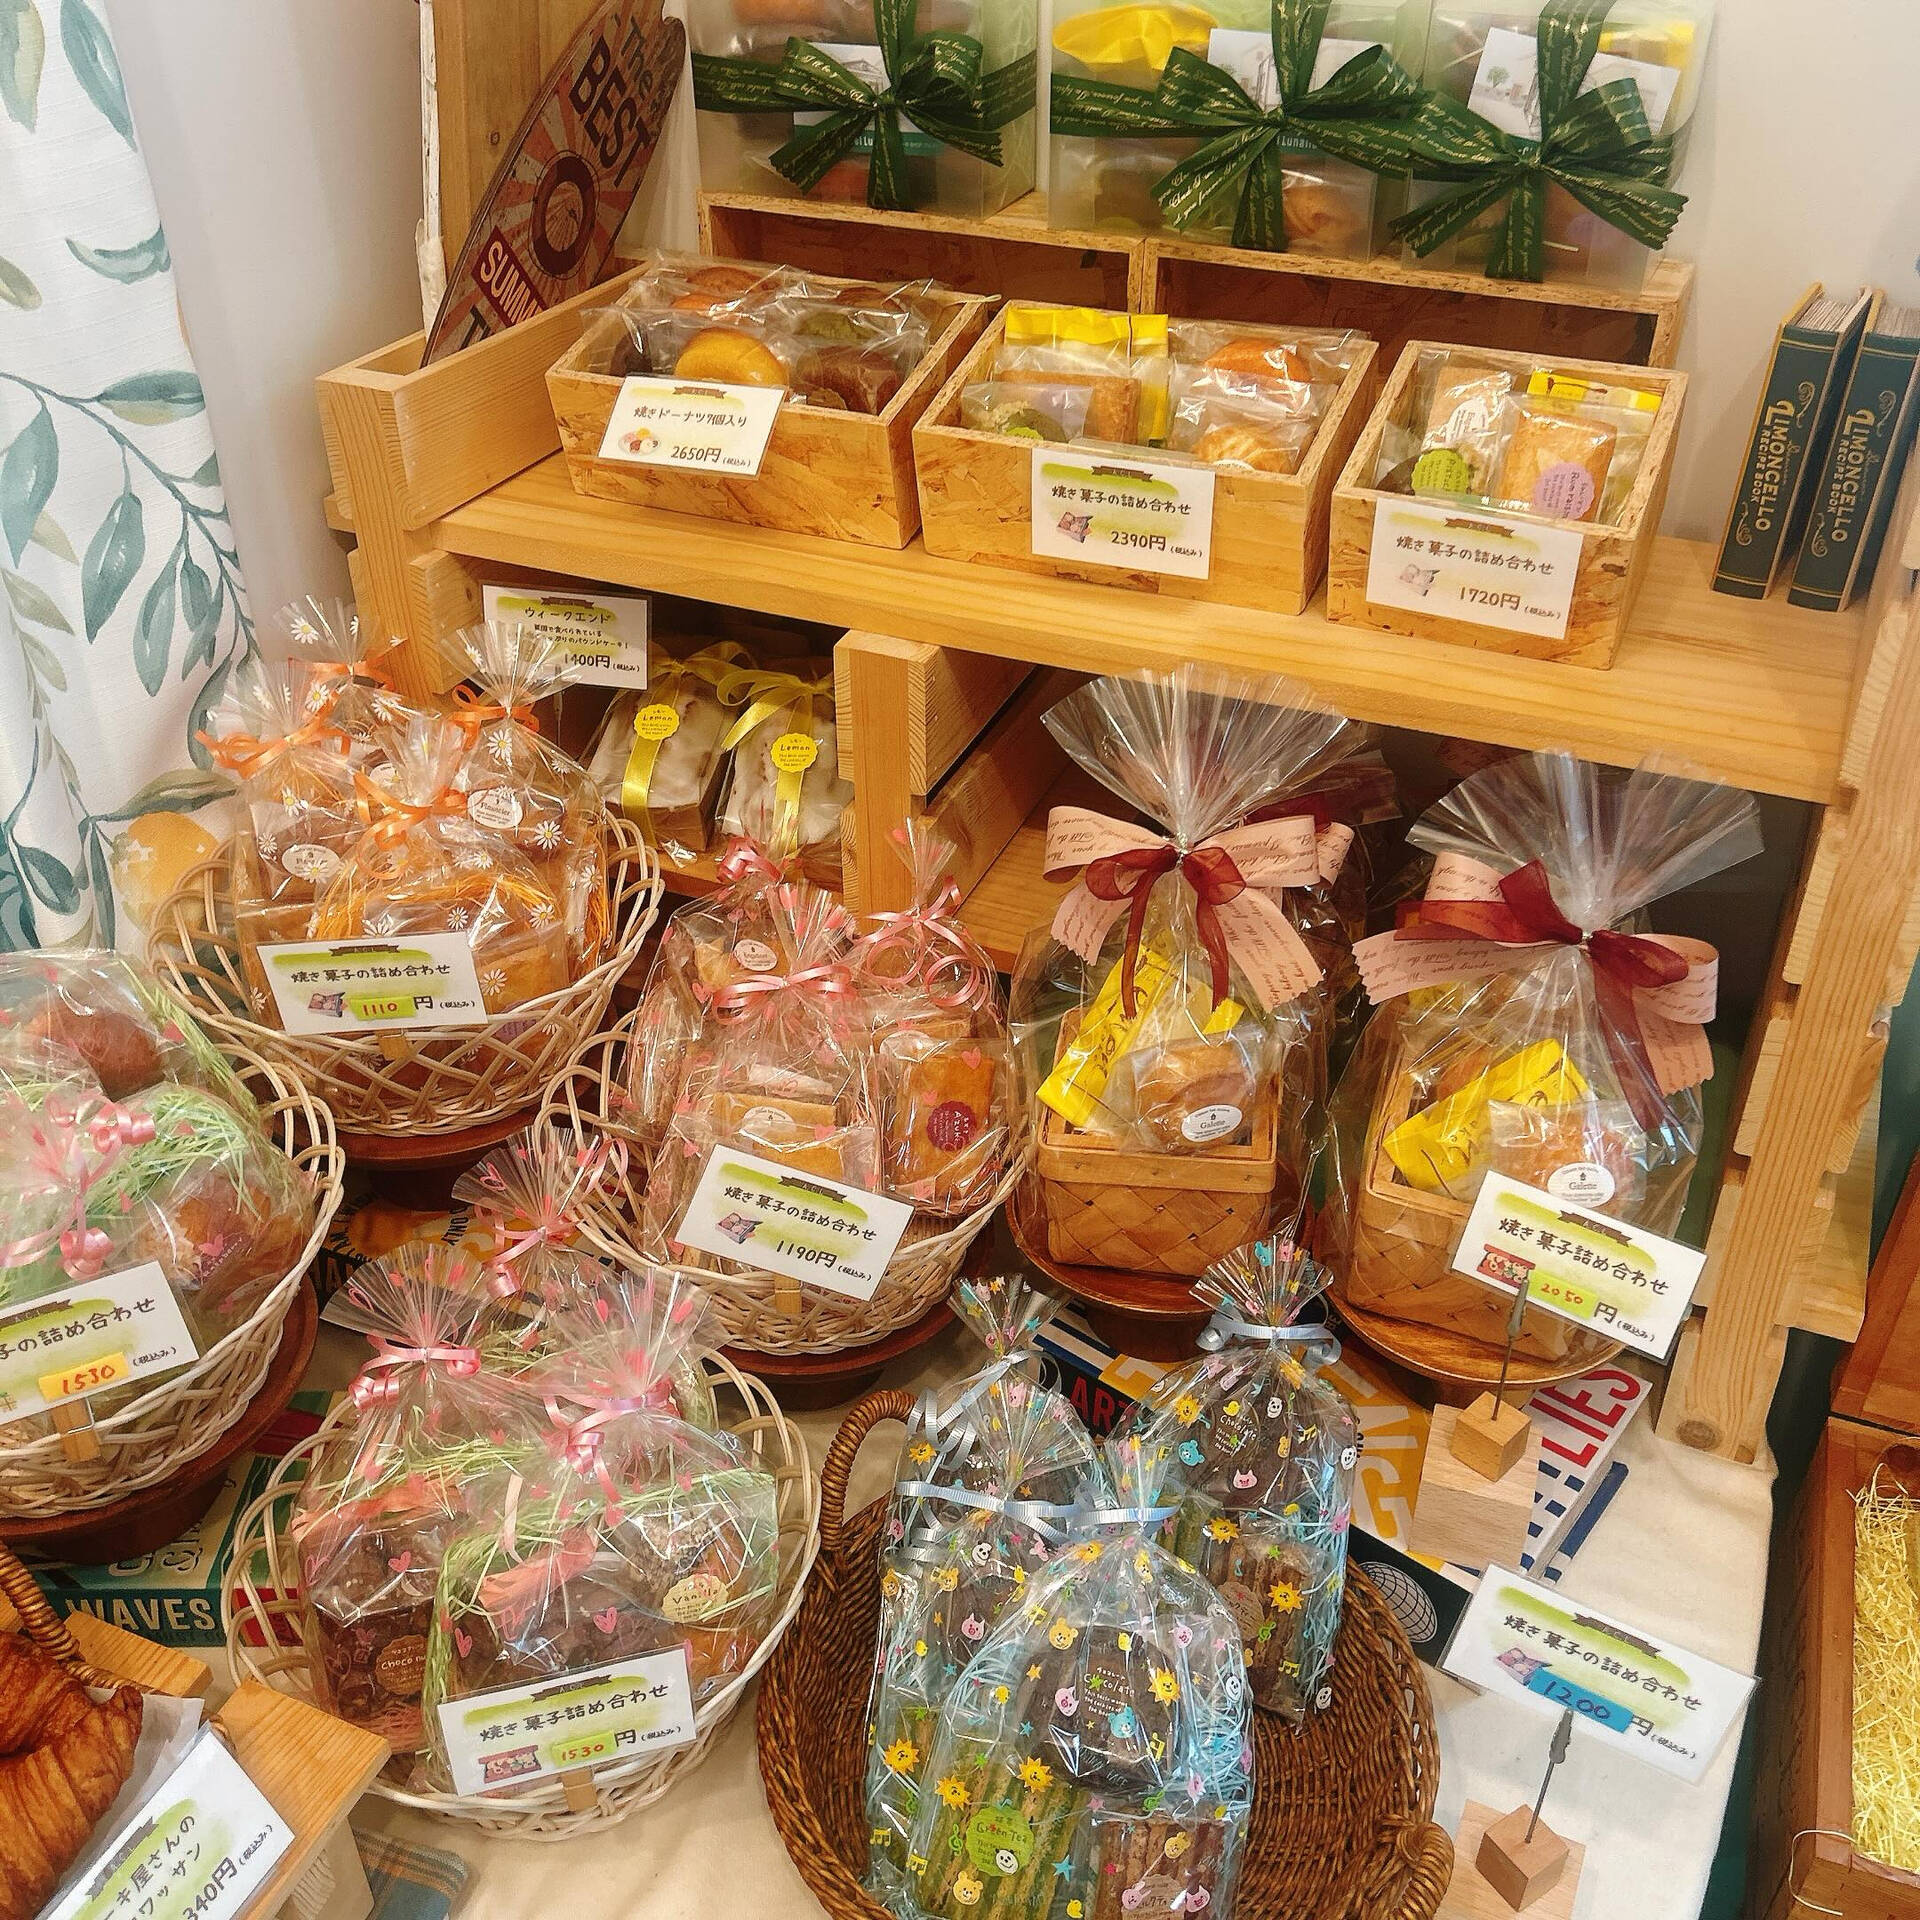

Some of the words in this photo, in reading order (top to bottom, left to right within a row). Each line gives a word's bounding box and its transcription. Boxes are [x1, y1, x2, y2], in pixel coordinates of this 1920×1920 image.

[569, 35, 651, 188] BEST
[671, 446, 722, 463] 2650円
[1755, 400, 1795, 531] LIMONCELLO
[1756, 429, 1771, 471] RECIPE
[1833, 438, 1850, 480] RECIPE
[1750, 472, 1764, 503] BOOK
[1831, 409, 1875, 542] LIMONCELLO
[1051, 484, 1192, 516] 焼き菓子の詰め合わせ
[1826, 482, 1842, 513] BOOK
[1110, 531, 1166, 552] 2390円
[1396, 535, 1555, 575] 焼き菓子の詰め合わせ
[1459, 586, 1520, 611] 1720円
[524, 606, 611, 624] ウィークエンド
[291, 964, 450, 983] 焼き菓子の詰め合わせ
[414, 996, 434, 1011] 円
[724, 1186, 877, 1242] 焼き菓子の詰め合わせ
[776, 1239, 838, 1269] 1190円
[1498, 1216, 1670, 1296] 焼き菓子詰め合わせ
[1594, 1301, 1618, 1324] 円
[61, 1364, 116, 1395] 1530
[1503, 1614, 1702, 1712] 焼き菓子の詰め合わせ
[479, 1684, 669, 1742] 焼き菓子詰め合わせ
[1543, 1680, 1612, 1720] 1200
[561, 1743, 605, 1761] 1530
[614, 1728, 637, 1747] 円
